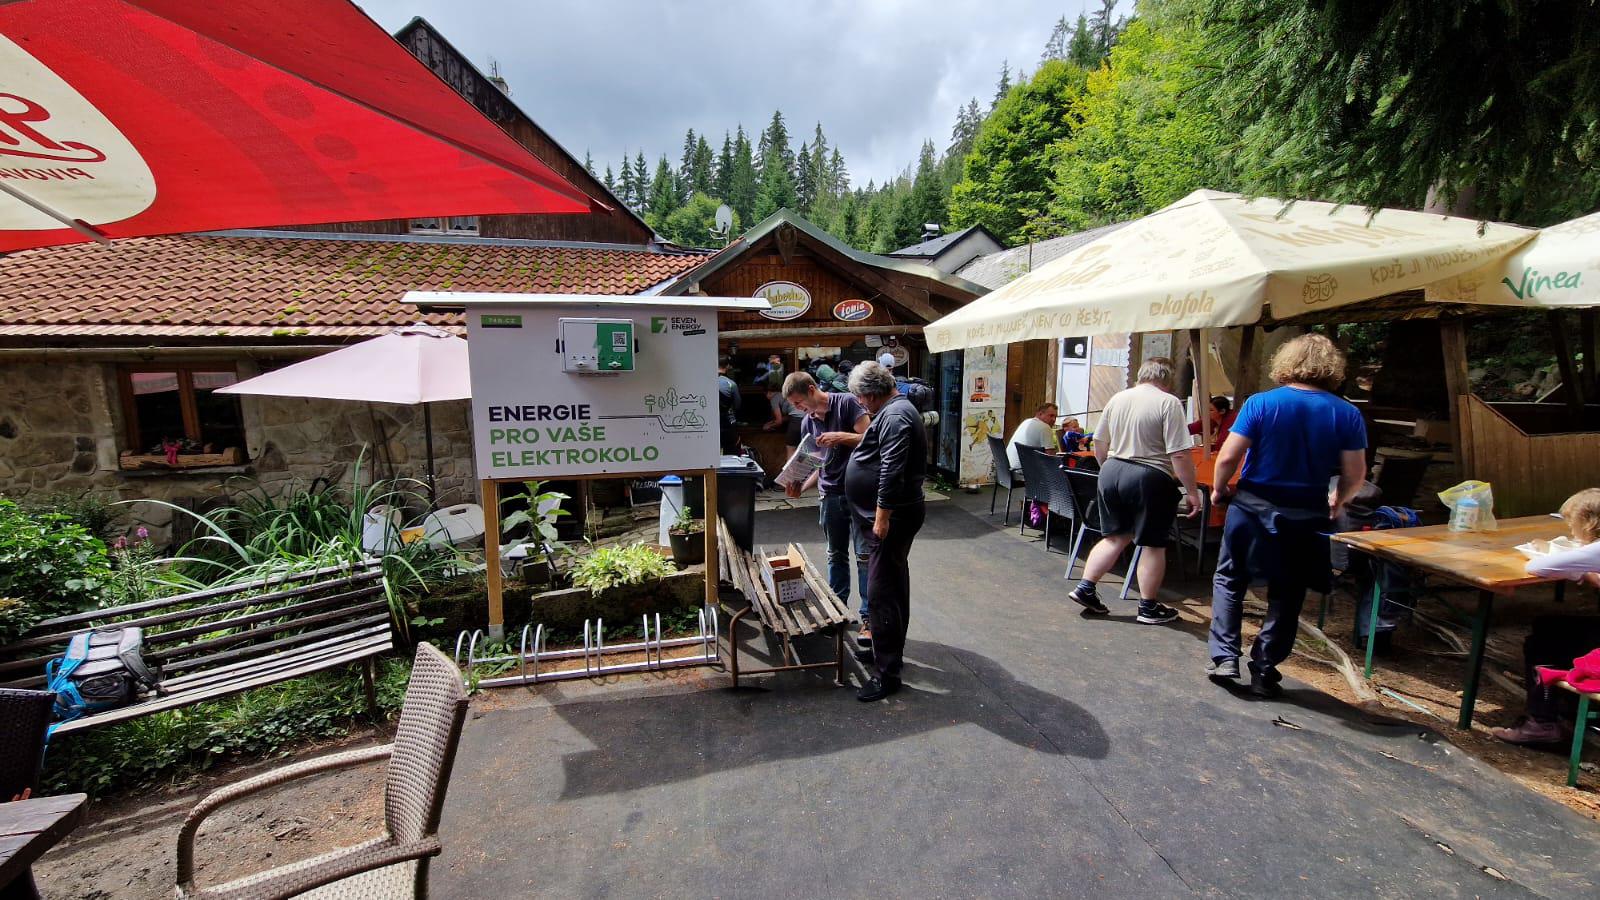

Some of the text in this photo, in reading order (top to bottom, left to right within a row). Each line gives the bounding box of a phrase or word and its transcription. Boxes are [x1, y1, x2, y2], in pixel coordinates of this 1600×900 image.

[1369, 258, 1407, 286] KDYŽ
[1410, 260, 1421, 278] JI
[1501, 266, 1582, 300] Vinea
[1160, 289, 1215, 321] kofola
[1059, 312, 1072, 328] CO
[488, 404, 591, 422] ENERGIE
[490, 422, 606, 445] PRO VAŠE
[491, 445, 660, 468] ELEKTROKOLO
